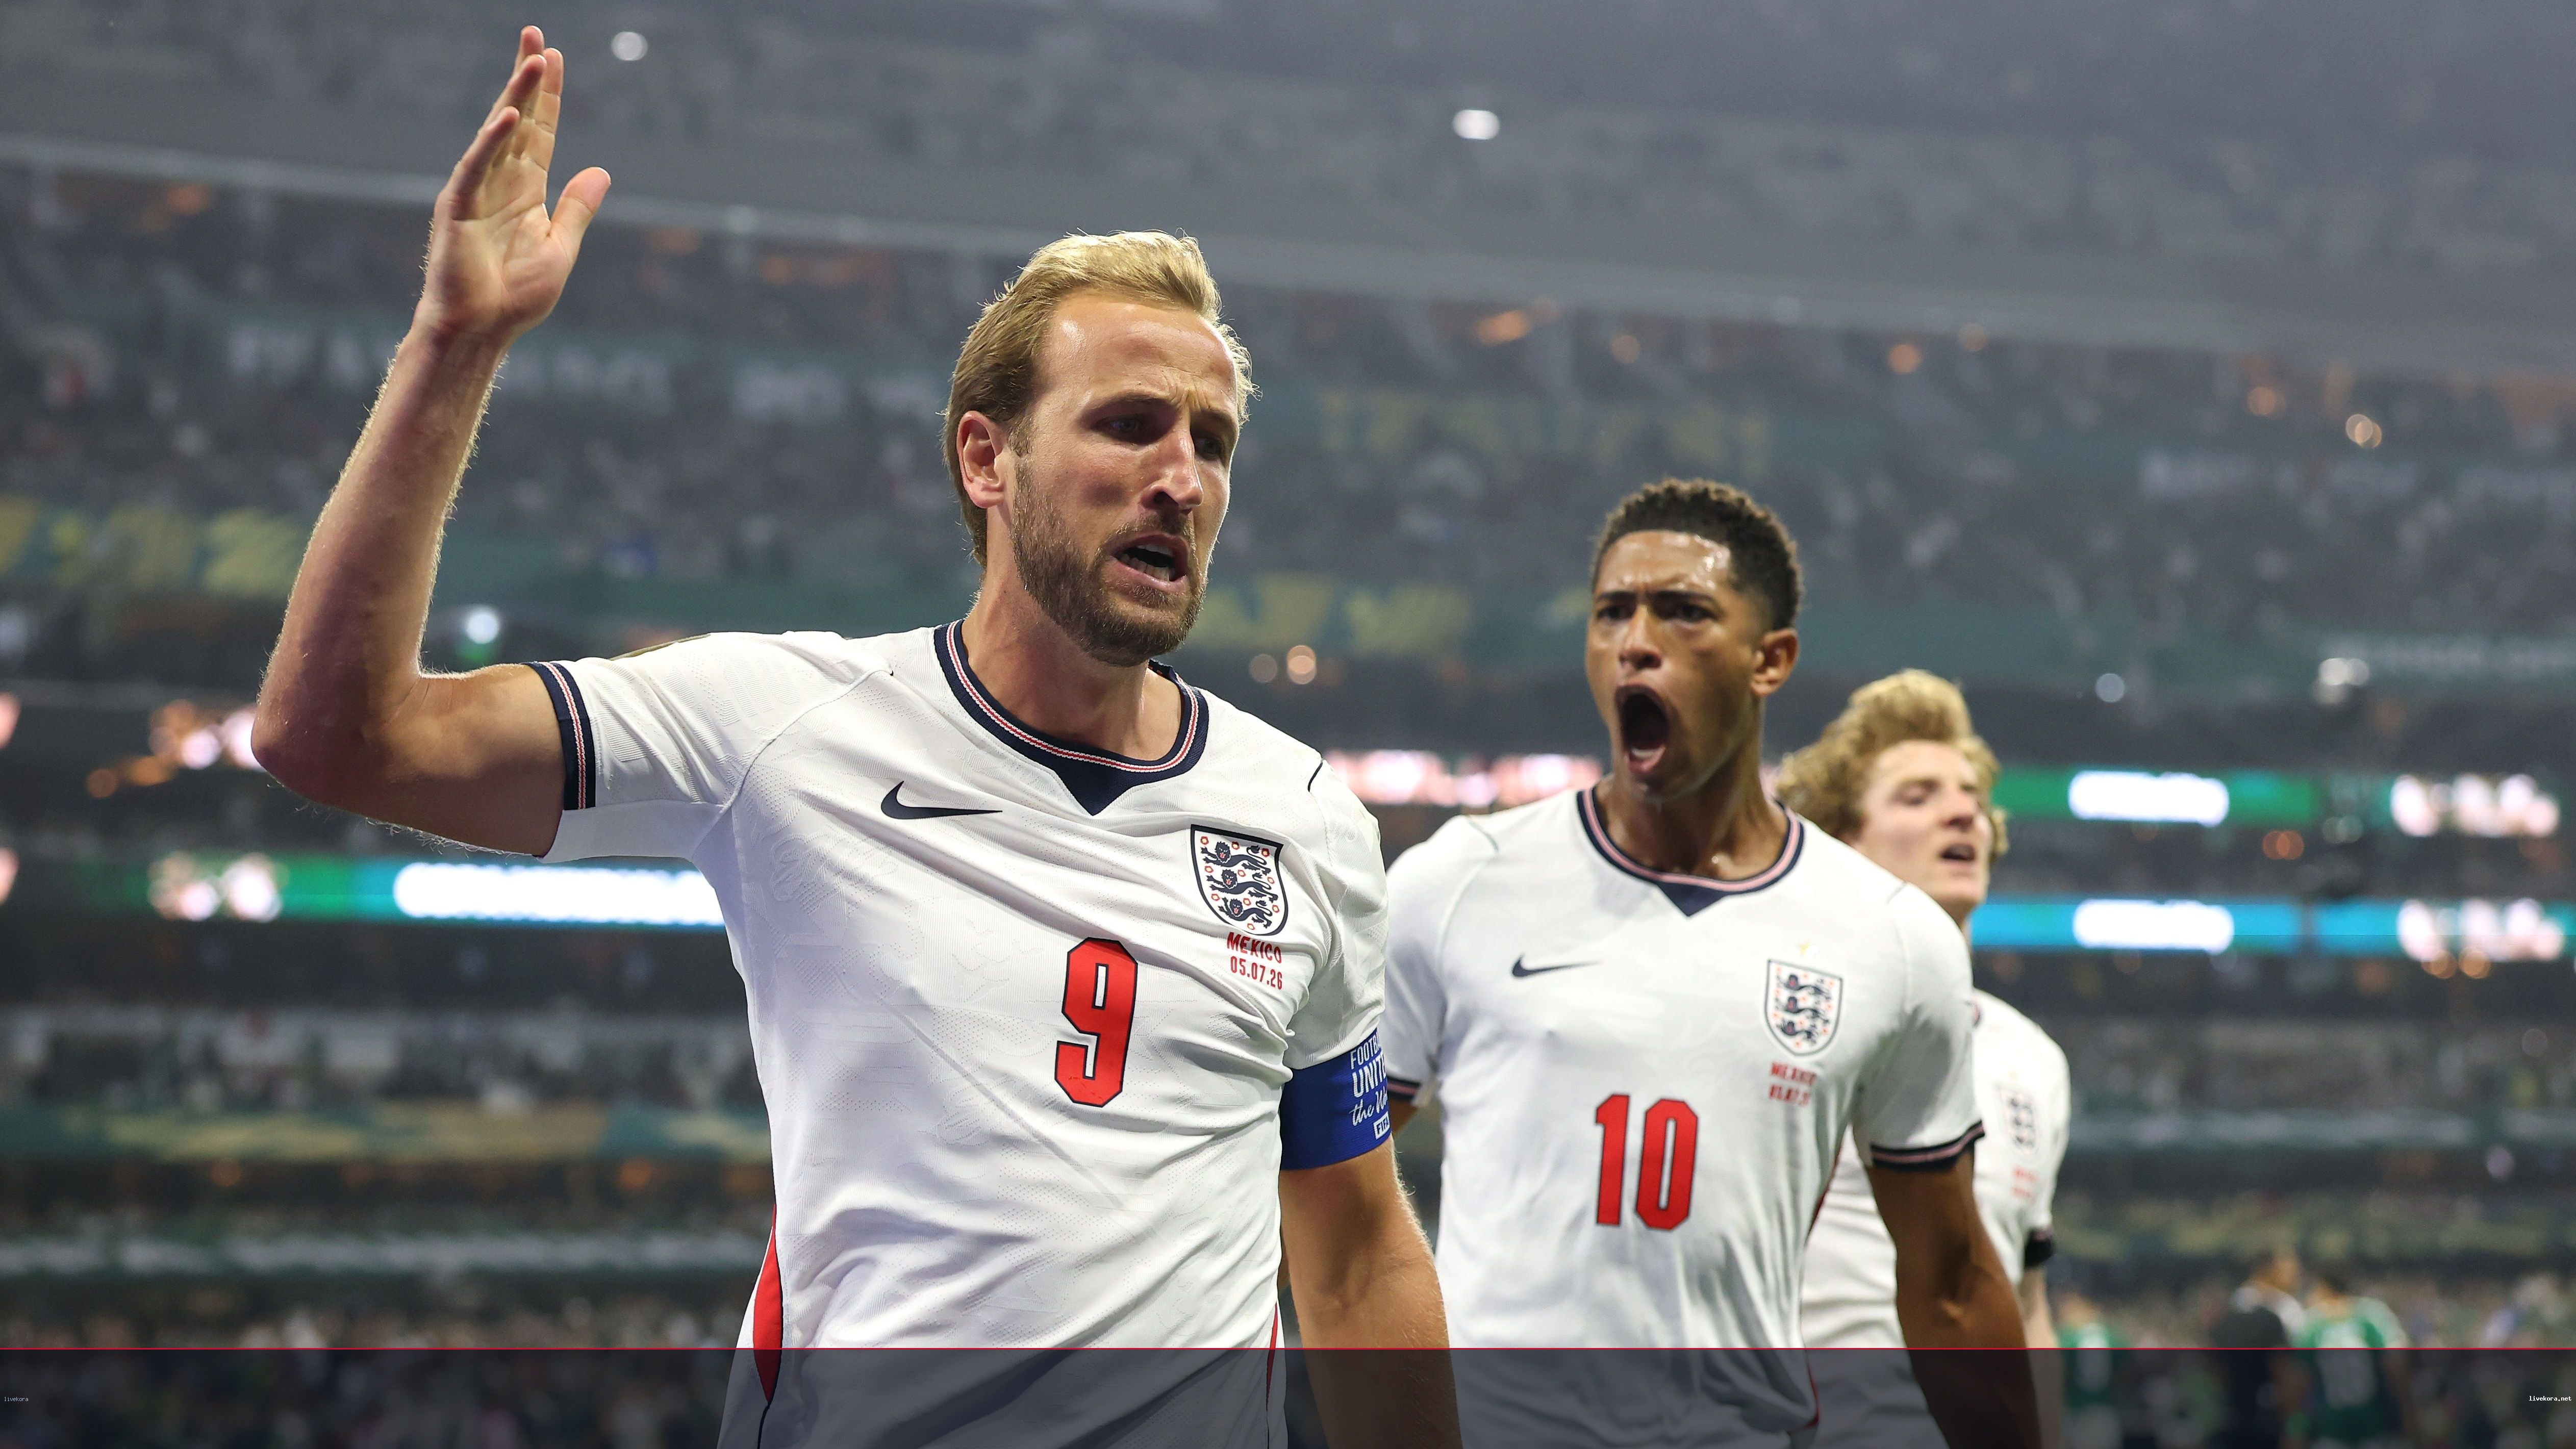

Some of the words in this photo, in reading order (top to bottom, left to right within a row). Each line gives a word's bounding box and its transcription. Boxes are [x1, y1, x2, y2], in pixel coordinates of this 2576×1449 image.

[1227, 932, 1282, 963] MEXICO
[1230, 955, 1282, 990] 05.07.26
[1054, 937, 1138, 1107] 9
[1349, 1098, 1374, 1126] the
[1596, 1094, 1700, 1229] 10
